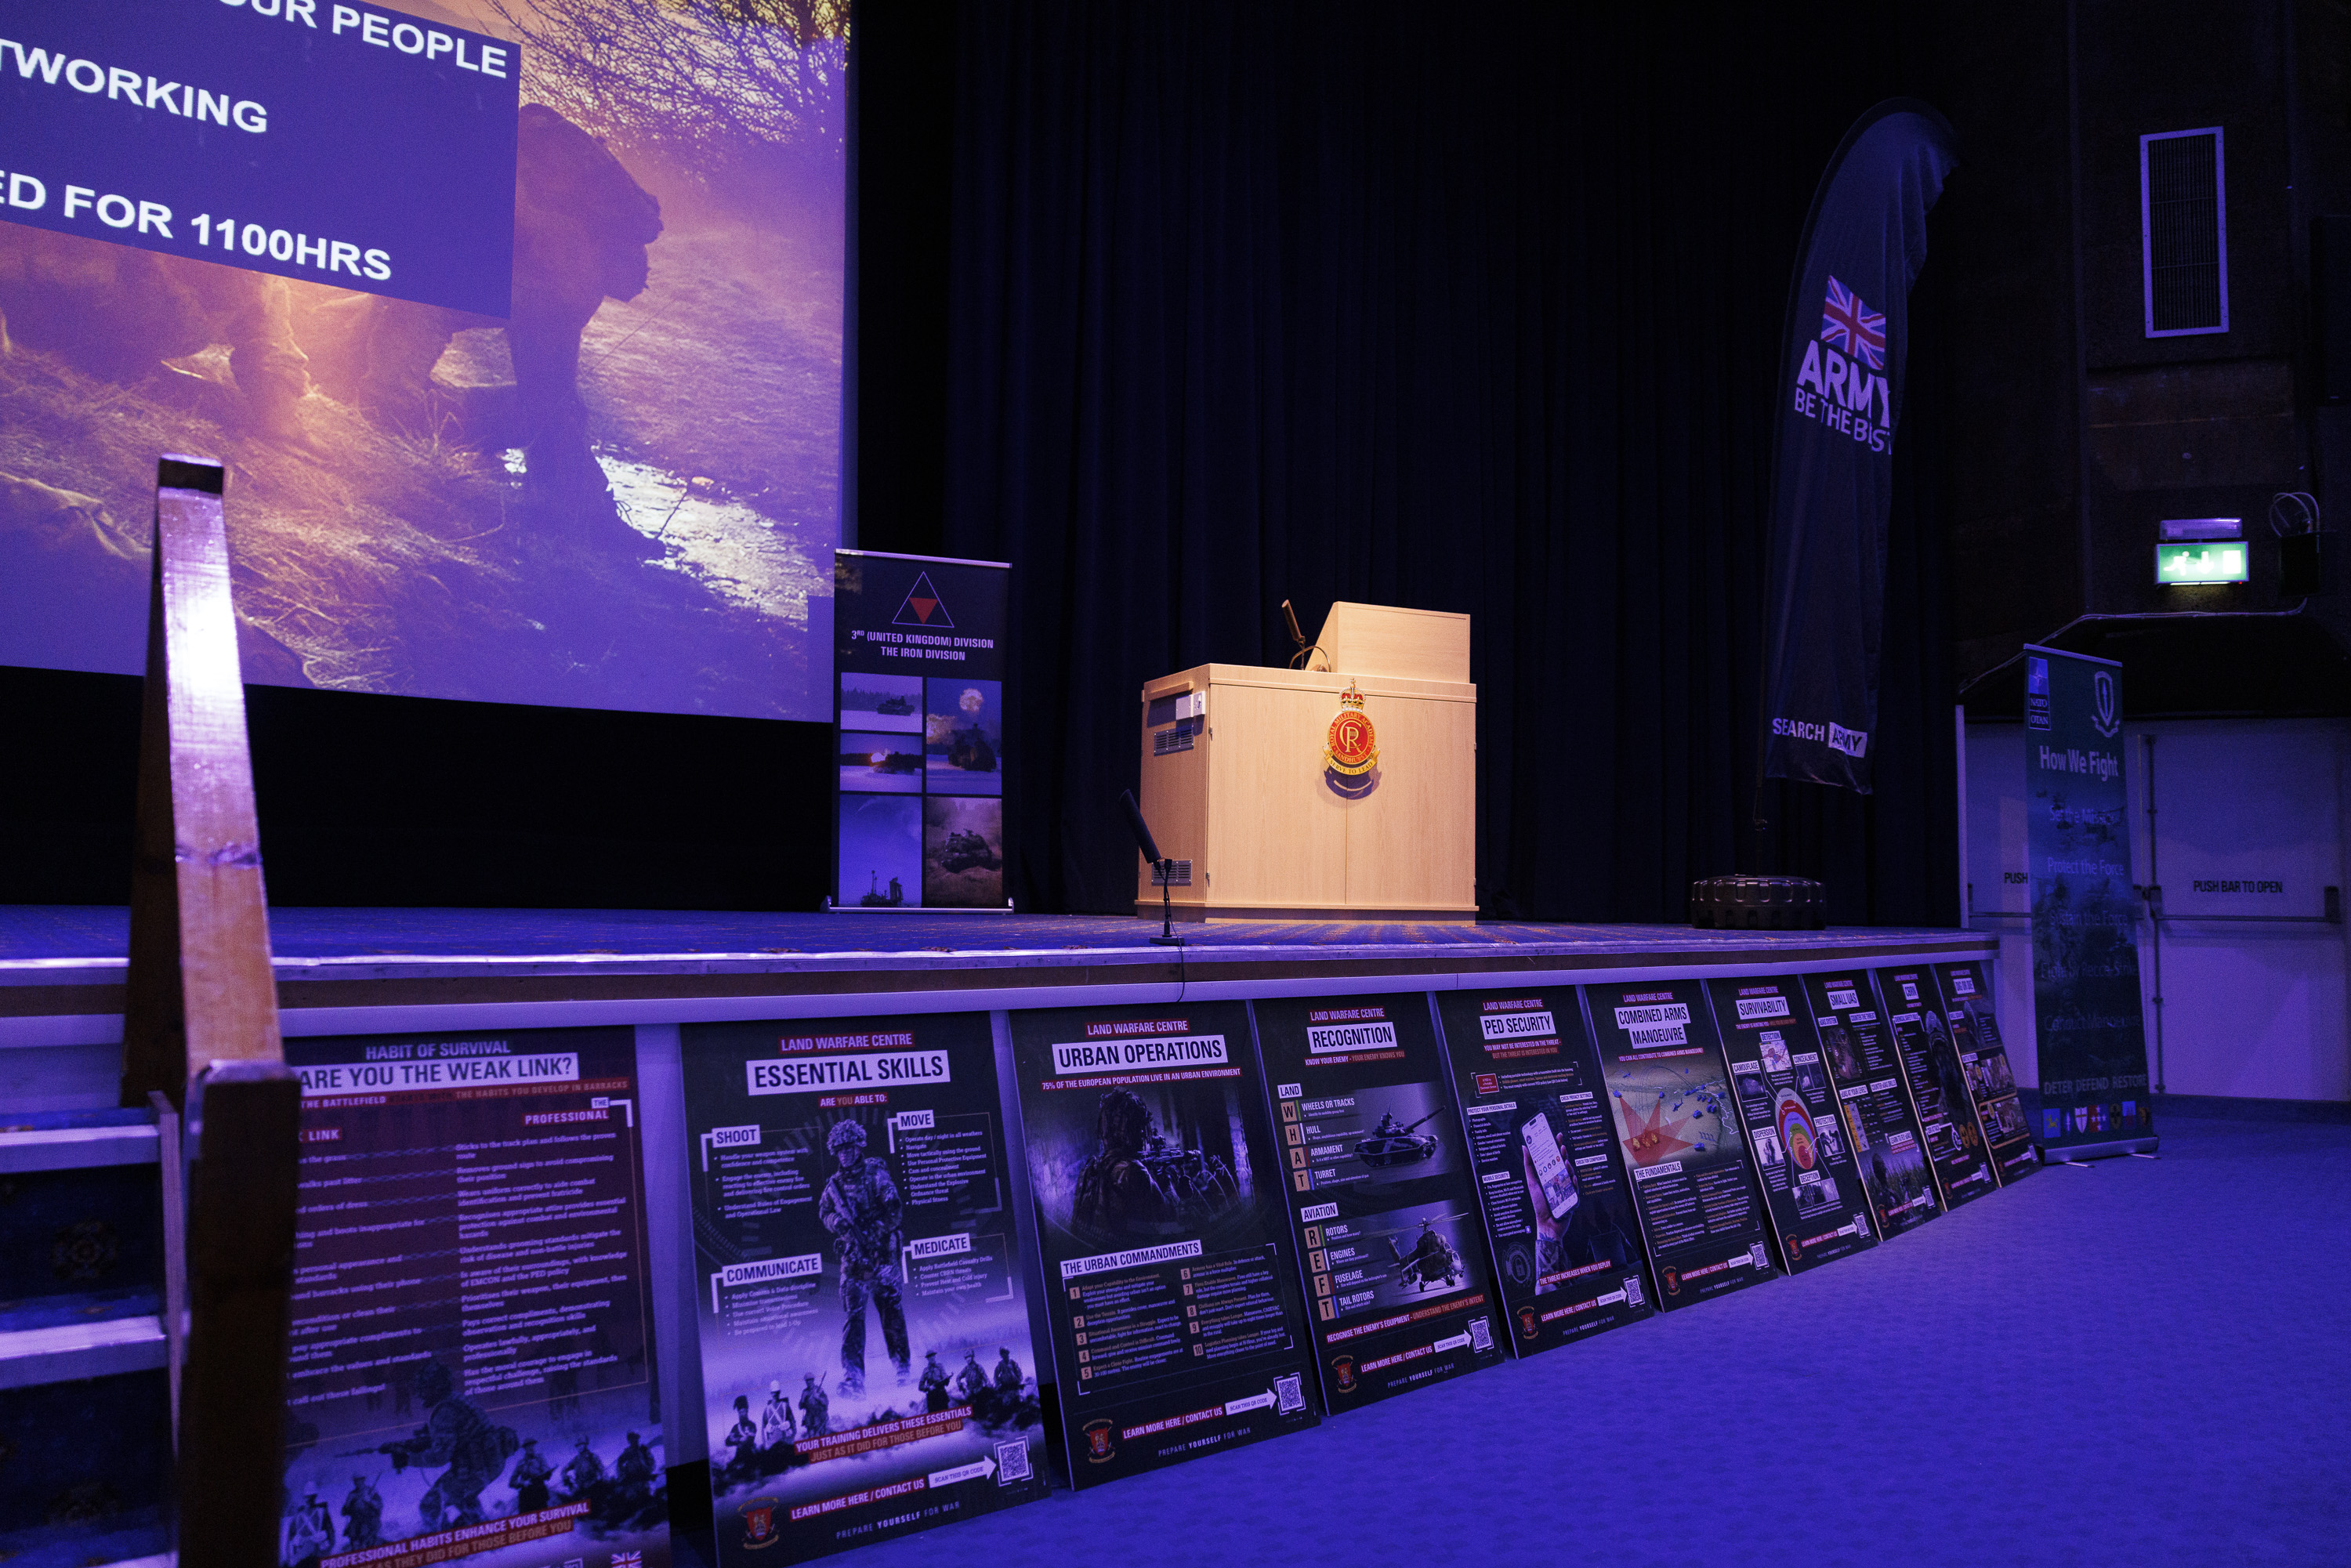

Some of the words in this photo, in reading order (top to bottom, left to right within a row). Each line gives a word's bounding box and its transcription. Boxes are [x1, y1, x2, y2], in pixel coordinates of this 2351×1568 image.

[204, 0, 317, 28] UR
[332, 4, 508, 79] PEOPLE
[0, 169, 46, 211] D
[63, 184, 173, 238] FOR
[190, 213, 392, 281] 1100HRS
[1796, 339, 1890, 428] ARMY
[1795, 387, 1817, 418] BE
[1820, 398, 1852, 435] THE
[867, 631, 903, 642] (UNITED
[906, 633, 951, 645] KINGDOM)
[954, 636, 993, 648] DIVISION
[881, 646, 897, 656] THE
[900, 647, 922, 657] IRON
[925, 649, 965, 660] DIVISION
[2030, 697, 2048, 708] NATO
[1335, 711, 1361, 725] MILITARY
[2030, 715, 2049, 726] OTAN
[1772, 717, 1825, 742] SEARCH
[1832, 726, 1862, 751] ARMY
[1335, 750, 1368, 764] SANDHURST
[2039, 745, 2067, 771] How
[2067, 748, 2087, 774] We
[2088, 751, 2118, 782] Fight
[1330, 759, 1346, 774] SERVE
[1358, 761, 1373, 773] LEAD
[2004, 872, 2028, 884] PUSH
[2194, 881, 2219, 892] PUSH
[2220, 881, 2241, 893] BAR
[2243, 882, 2255, 893] TO
[2257, 882, 2283, 893] OPEN
[1483, 1001, 1498, 1010] LAND
[1498, 1000, 1523, 1009] WARFARE
[1523, 999, 1543, 1008] CENTRE
[1830, 994, 1847, 1005] SMALL
[1846, 993, 1857, 1004] UAS
[1310, 1011, 1328, 1020] LAND
[1329, 1009, 1360, 1019] WARFARE
[1360, 1008, 1385, 1017] CENTRE
[1739, 1000, 1787, 1015] SURVIVABILITY
[1617, 1009, 1662, 1023] COMBINED
[1662, 1007, 1686, 1020] ARMS
[1087, 1023, 1112, 1034] LAND
[1114, 1022, 1155, 1034] WARFARE
[1156, 1020, 1187, 1031] CENTRE
[1483, 1019, 1505, 1034] PED
[1505, 1016, 1551, 1032] SECURITY
[781, 1037, 813, 1051] LAND
[816, 1035, 869, 1049] WARFARE
[871, 1033, 912, 1046] CENTRE
[1312, 1026, 1393, 1046] RECOGNITION
[1632, 1027, 1683, 1043] MANOEUVRE
[366, 1045, 411, 1059] HABIT
[416, 1044, 437, 1057] OF
[438, 1040, 511, 1056] SURVIVAL
[1058, 1045, 1121, 1067] URBAN
[1125, 1039, 1222, 1063] OPERATIONS
[1794, 1053, 1817, 1063] CONCEALMENT
[300, 1069, 342, 1088] ARE
[348, 1066, 393, 1085] YOU
[400, 1063, 441, 1082] THE
[447, 1060, 509, 1080] WEAK
[516, 1057, 573, 1076] LINK?
[755, 1059, 872, 1087] ESSENTIAL
[875, 1055, 944, 1079] SKILLS
[1733, 1063, 1759, 1071] CAMOUFLAGE
[1042, 1081, 1055, 1090] 75%
[1078, 1077, 1112, 1087] EUROPEAN
[1113, 1074, 1150, 1085] POPULATION
[1181, 1070, 1201, 1079] URBAN
[1202, 1067, 1241, 1077] ENVIRONMENT
[2045, 1080, 2073, 1095] DETER
[2076, 1077, 2110, 1092] DEFEND
[2113, 1074, 2146, 1088] RESTORE
[1281, 1085, 1299, 1096] LAND
[301, 1099, 318, 1108] THE
[322, 1096, 386, 1106] BATTLEFIELD
[593, 1098, 608, 1107] THE
[820, 1096, 835, 1106] ARE
[836, 1095, 853, 1105] YOU
[853, 1095, 874, 1104] ABLE
[875, 1094, 887, 1103] TO:
[1301, 1101, 1324, 1111] WHEELS
[1334, 1098, 1354, 1107] TRACKS
[524, 1110, 608, 1124] PROFESSIONAL
[900, 1114, 931, 1126] MOVE
[308, 1129, 339, 1141] LINK
[716, 1129, 755, 1143] SHOOT
[1306, 1125, 1320, 1134] HULL
[1310, 1144, 1342, 1157] ARMAMENT
[1315, 1168, 1335, 1179] TURRET
[1636, 1169, 1645, 1178] THE
[1645, 1163, 1680, 1176] FUNDAMENTALS
[1304, 1205, 1335, 1219] AVIATION
[1325, 1225, 1348, 1236] ROTORS
[915, 1237, 968, 1255] MEDICATE
[1063, 1261, 1082, 1274] THE
[1084, 1255, 1118, 1271] URBAN
[1120, 1243, 1199, 1265] COMMANDMENTS
[1330, 1248, 1355, 1259] ENGINES
[726, 1258, 818, 1282] COMMUNICATE
[1335, 1269, 1363, 1283] FUSELAGE
[1339, 1295, 1352, 1305] TAIL
[1352, 1291, 1374, 1303] ROTORS
[795, 1437, 820, 1451] YOUR
[820, 1429, 861, 1447] TRAINING
[861, 1421, 900, 1438] DELIVERS
[900, 1416, 926, 1429] THESE
[926, 1407, 971, 1425] ESSENTIALS
[810, 1448, 832, 1461] JUST
[833, 1445, 847, 1457] AS
[847, 1443, 857, 1454] IT
[857, 1439, 871, 1451] DID
[871, 1436, 888, 1448] FOR
[889, 1430, 915, 1444] THOSE
[915, 1424, 947, 1439] BEFORE
[946, 1421, 962, 1432] YOU
[790, 1502, 820, 1518] LEARN
[821, 1497, 846, 1511] MORE
[847, 1491, 869, 1505] HERE
[875, 1481, 912, 1498] CONTACT
[913, 1479, 924, 1490] US
[321, 1540, 408, 1567] PROFESSIONAL
[410, 1530, 453, 1550] HABITS
[454, 1519, 508, 1541] ENHANCE
[509, 1512, 538, 1529] YOUR
[539, 1501, 589, 1522] SURVIVAL
